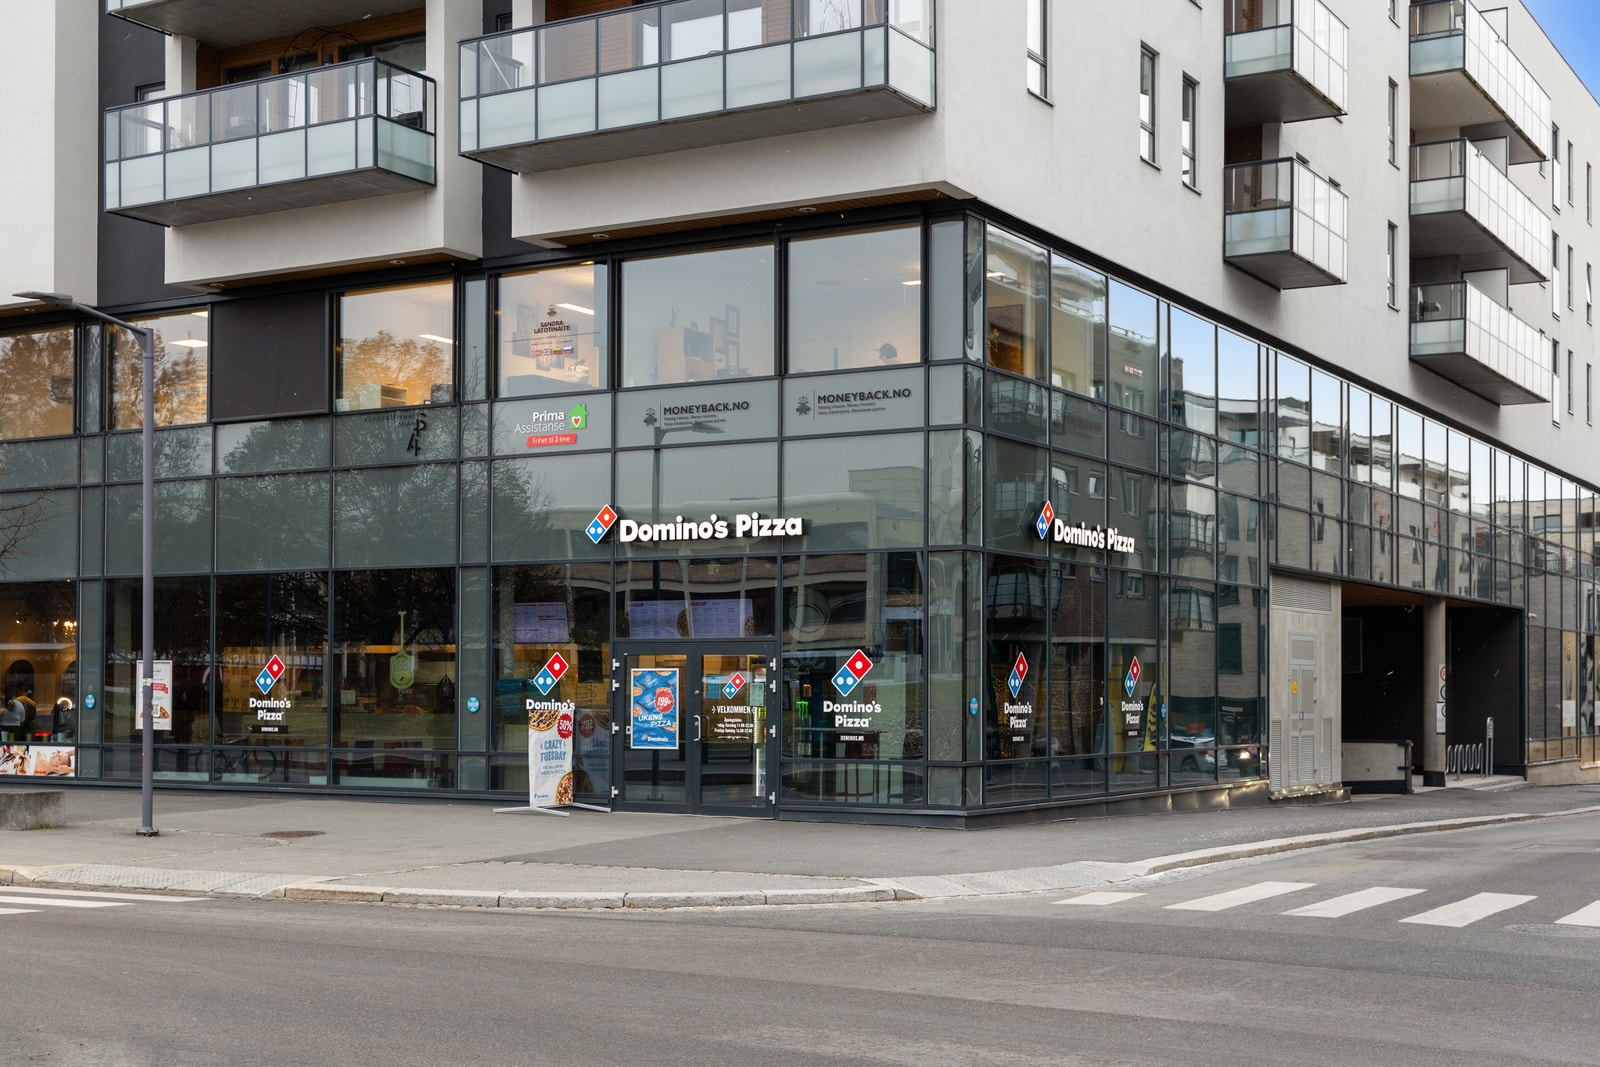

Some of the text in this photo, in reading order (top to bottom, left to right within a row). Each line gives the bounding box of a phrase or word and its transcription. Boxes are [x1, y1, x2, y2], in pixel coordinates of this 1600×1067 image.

[818, 388, 912, 404] MONEYBACK.NO
[663, 401, 749, 416] MONEYBACK.NO
[532, 411, 565, 422] Prima
[514, 422, 566, 434] Assistanse
[619, 511, 803, 543] Domino's Pizza
[1054, 518, 1135, 554] Domino's Pizza
[249, 697, 292, 709] Domino's
[525, 699, 576, 711] Domino's
[823, 700, 882, 713] Domino's
[1003, 701, 1033, 714] Domino's
[1121, 700, 1144, 712] Domino's
[257, 709, 283, 721] Pizza
[716, 705, 751, 714] VELKOMMEN
[638, 713, 663, 722] UKENS
[835, 714, 869, 728] Pizza
[1010, 716, 1027, 729] Pizza
[1125, 713, 1140, 725] Pizza
[559, 720, 572, 731] 50%
[650, 720, 671, 728] PIZZA
[544, 739, 562, 751] CRAZY
[540, 751, 567, 763] TUESDAY
